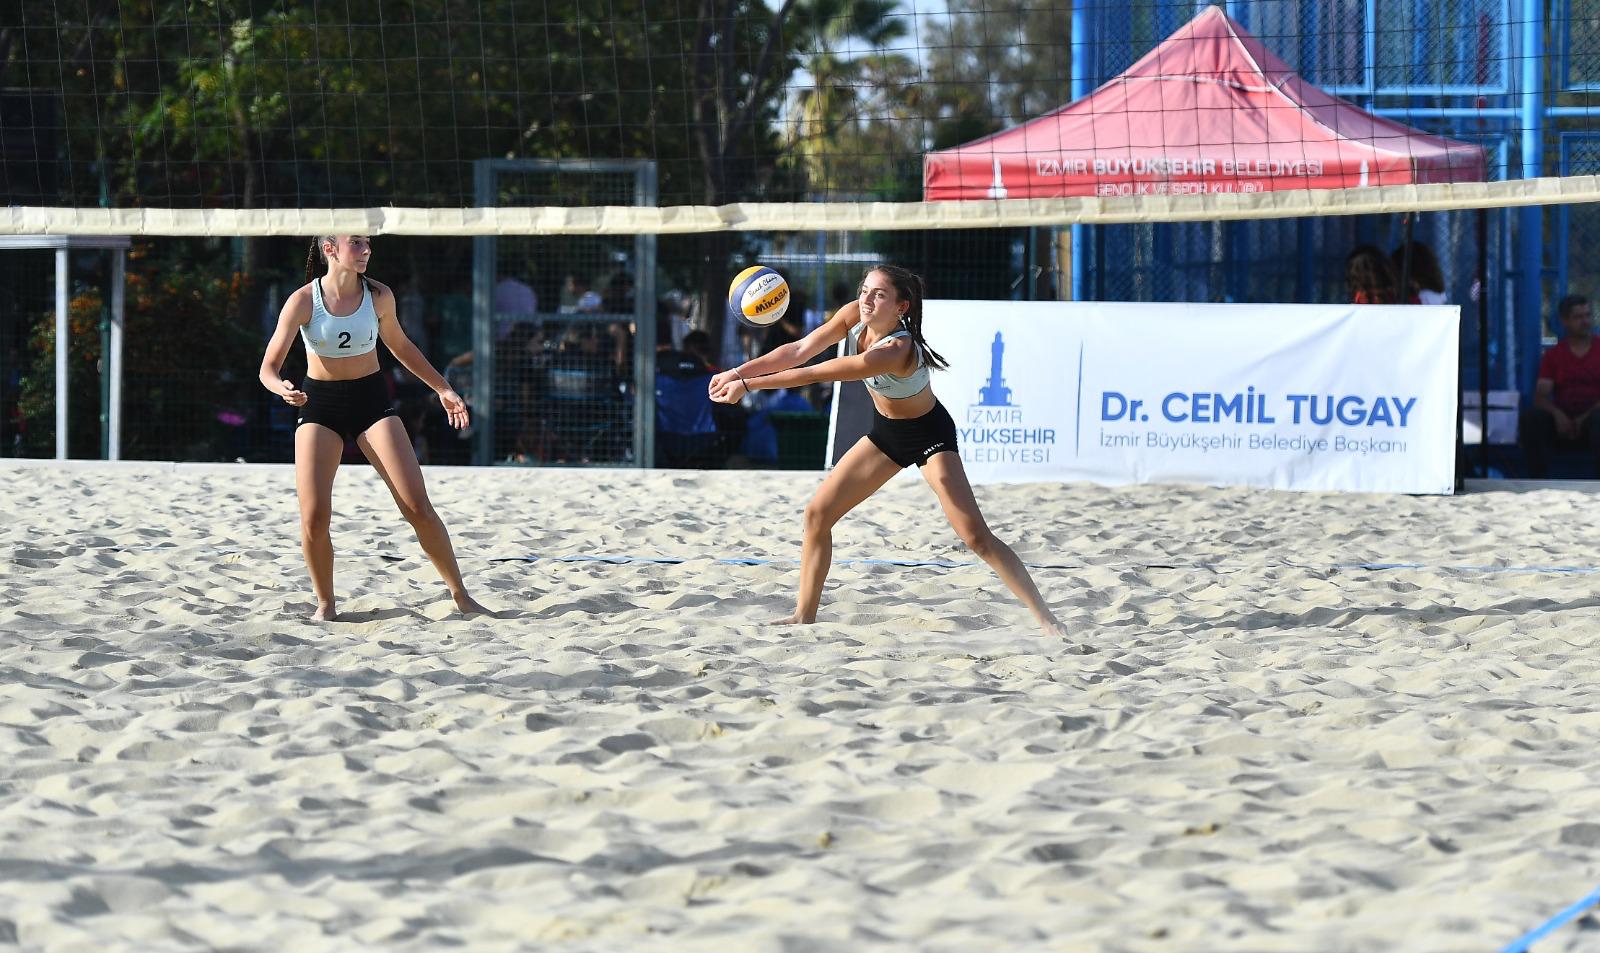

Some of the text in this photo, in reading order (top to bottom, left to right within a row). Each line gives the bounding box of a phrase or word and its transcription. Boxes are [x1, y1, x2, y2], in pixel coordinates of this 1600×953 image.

[1172, 182, 1208, 196] SPOR
[338, 331, 352, 349] 2
[1101, 386, 1417, 427] Dr. CEMİL TUGAY
[957, 425, 1056, 445] YÜKŞEHİR
[1146, 431, 1243, 453] Büyükşehir
[1249, 433, 1329, 455] Belediye
[963, 446, 1051, 463] LEDİYESİ
